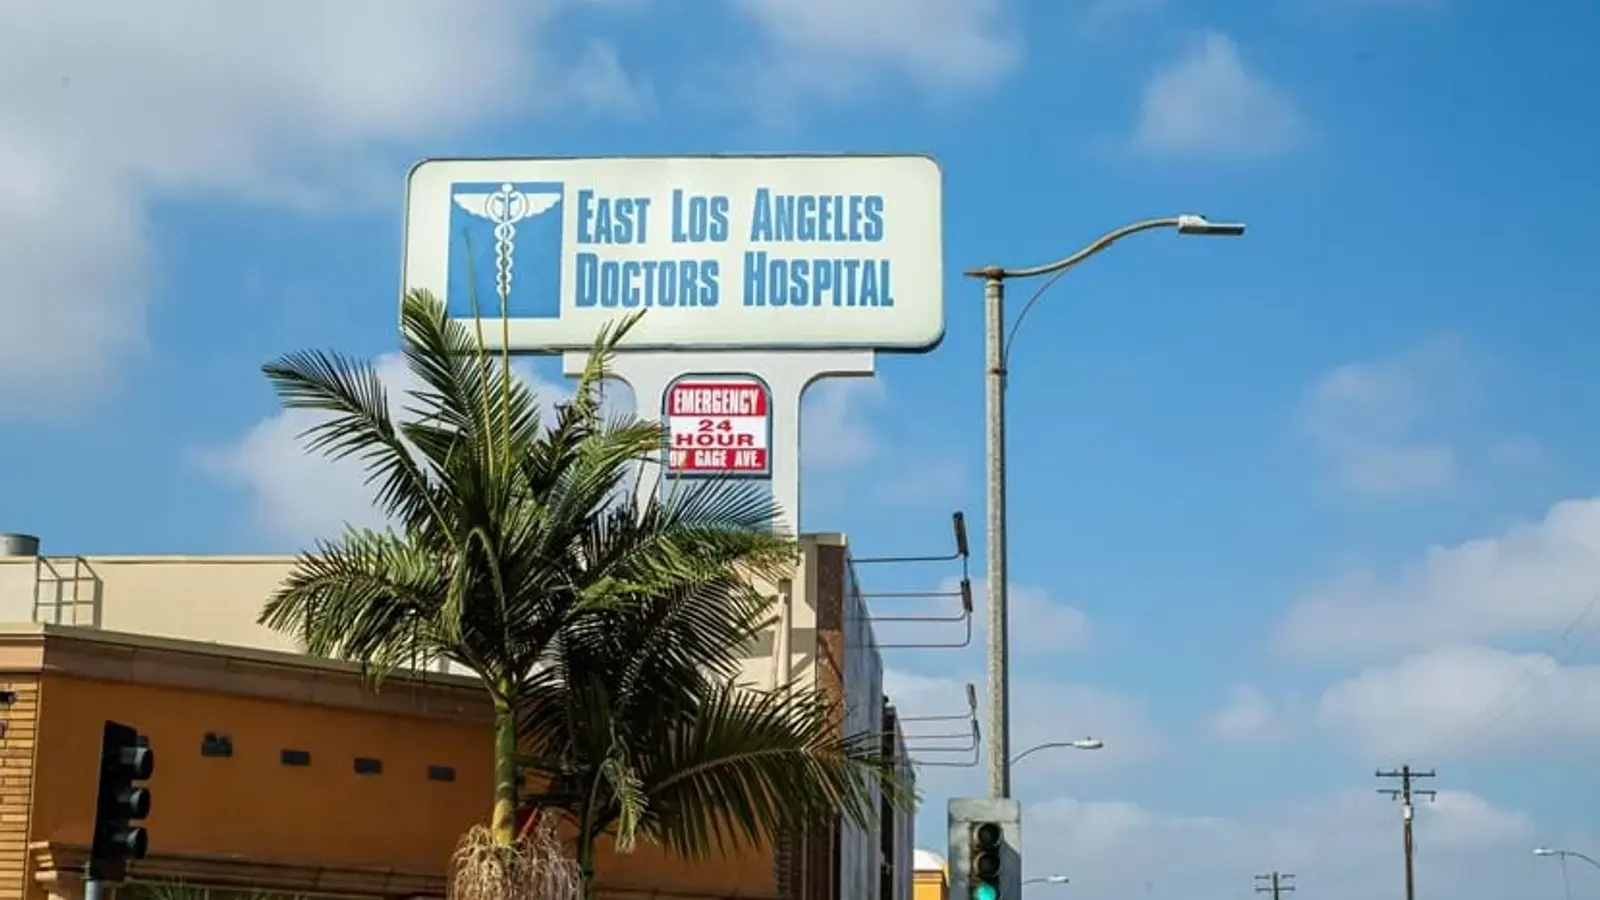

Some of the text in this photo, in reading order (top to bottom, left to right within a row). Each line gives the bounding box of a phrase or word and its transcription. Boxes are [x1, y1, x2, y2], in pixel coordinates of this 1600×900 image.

[577, 187, 884, 244] EAST LOS ANGELES
[575, 251, 895, 308] DOCTORS HOSPITAL
[674, 388, 759, 414] EMERGENCY
[698, 420, 732, 431] 24
[676, 434, 753, 446] HOUR
[695, 450, 727, 467] GAGE
